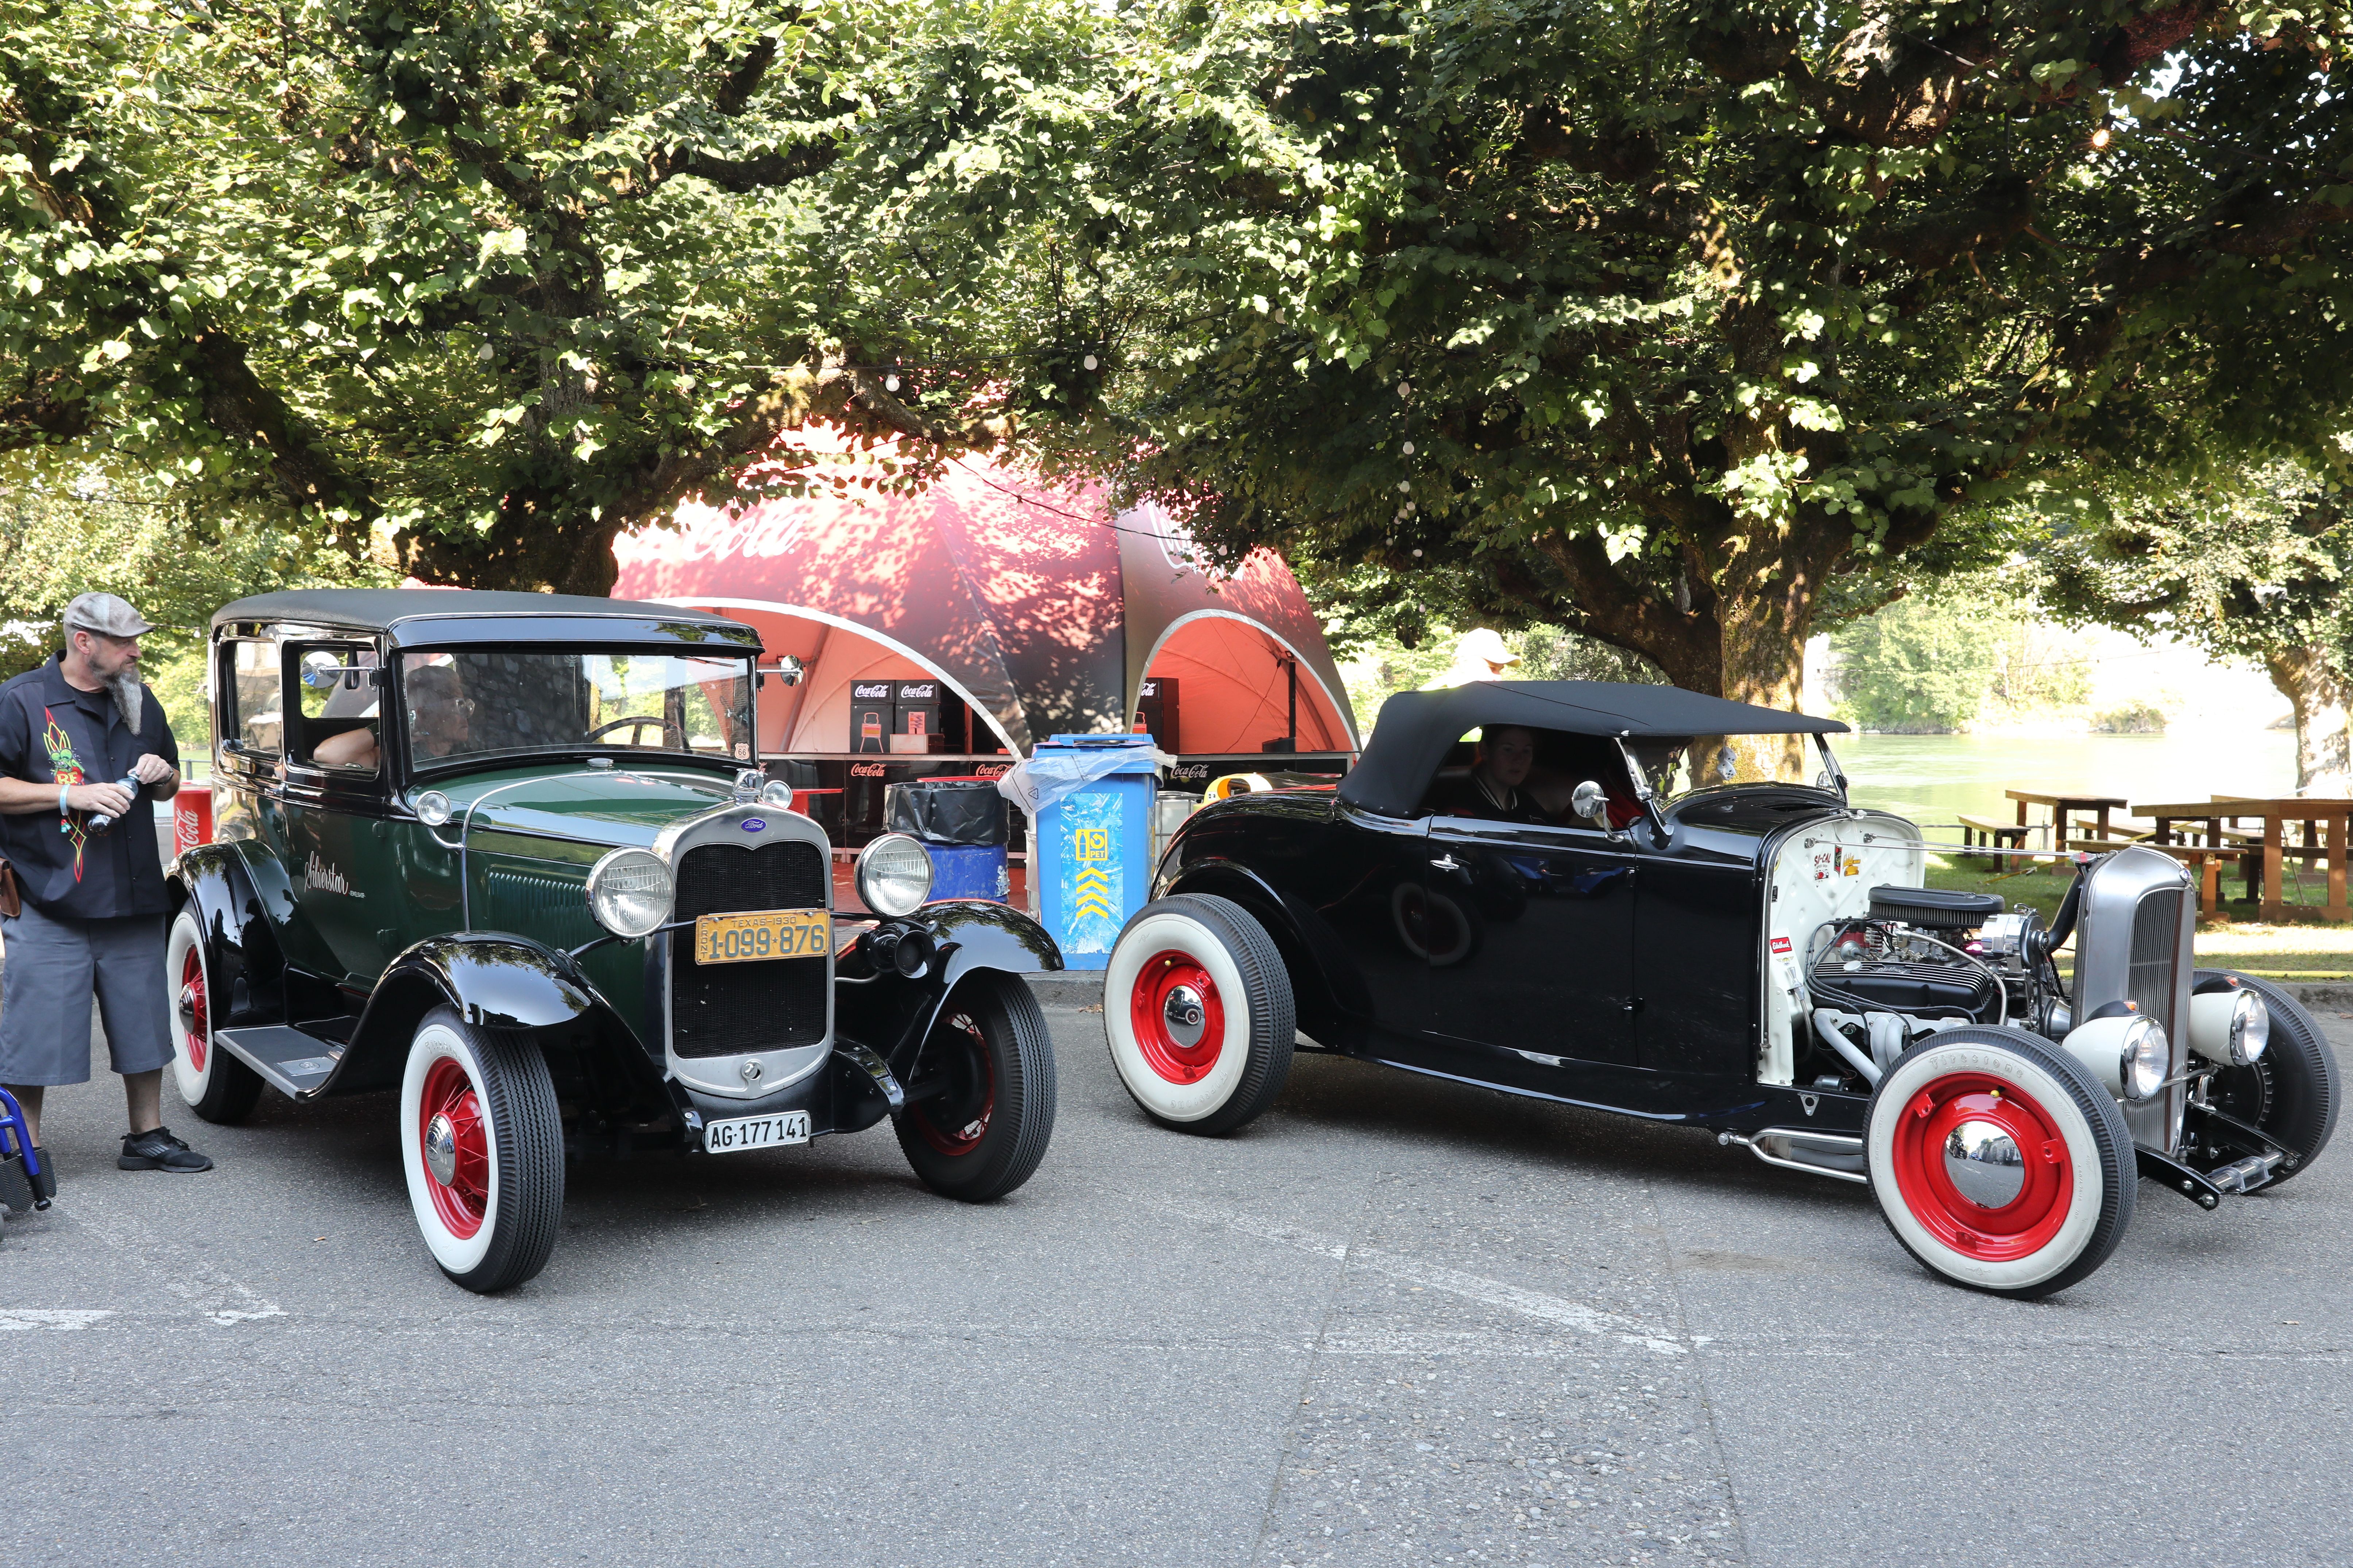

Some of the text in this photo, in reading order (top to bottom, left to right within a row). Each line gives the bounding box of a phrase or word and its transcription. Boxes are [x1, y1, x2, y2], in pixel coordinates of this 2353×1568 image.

[855, 685, 889, 698] Coca-Cola
[901, 685, 934, 698] Coca-Cola
[851, 763, 886, 776] Coca-Cola
[745, 820, 763, 829] Ford
[305, 851, 348, 895] Silverstar
[1772, 941, 1790, 950] Edelbrock
[1929, 1053, 2024, 1078] Firestone
[1170, 1069, 1228, 1109] Firestone
